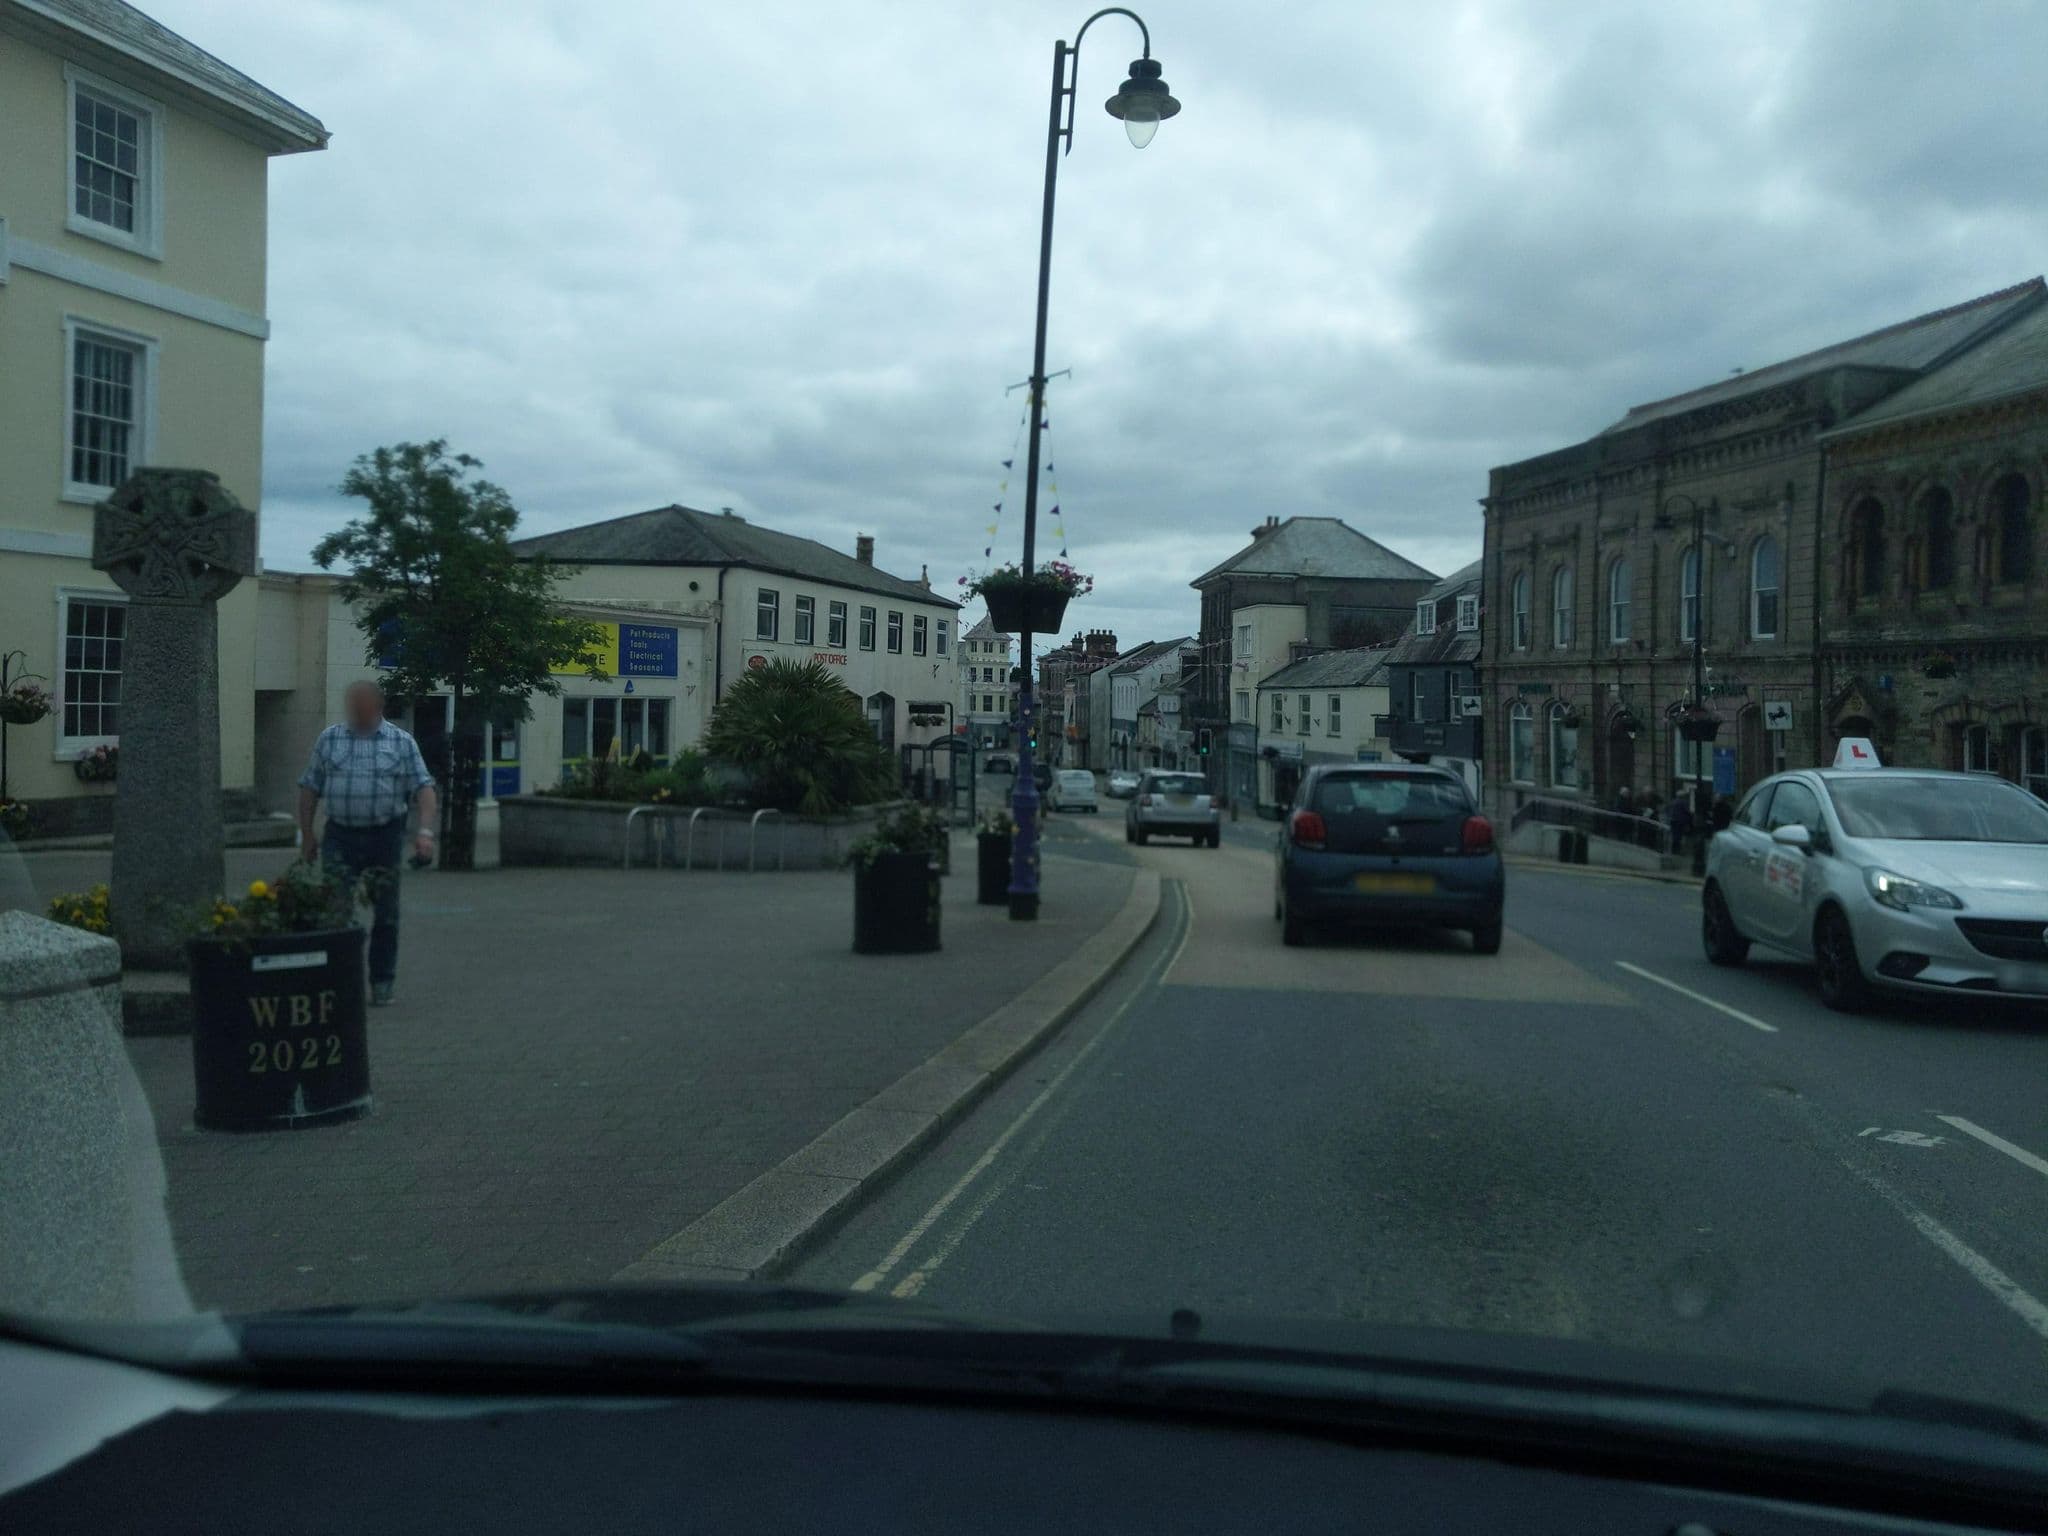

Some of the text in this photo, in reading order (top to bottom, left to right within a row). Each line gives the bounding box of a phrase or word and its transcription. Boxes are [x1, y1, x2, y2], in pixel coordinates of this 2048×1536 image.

[630, 629, 671, 640] Pet Products
[630, 640, 647, 649] Tools
[630, 651, 663, 661] Electrical
[829, 654, 847, 665] OFFICE
[630, 662, 663, 672] Seasonal
[1852, 745, 1867, 758] L
[249, 990, 337, 1029] WBF
[249, 1034, 343, 1073] 2022
